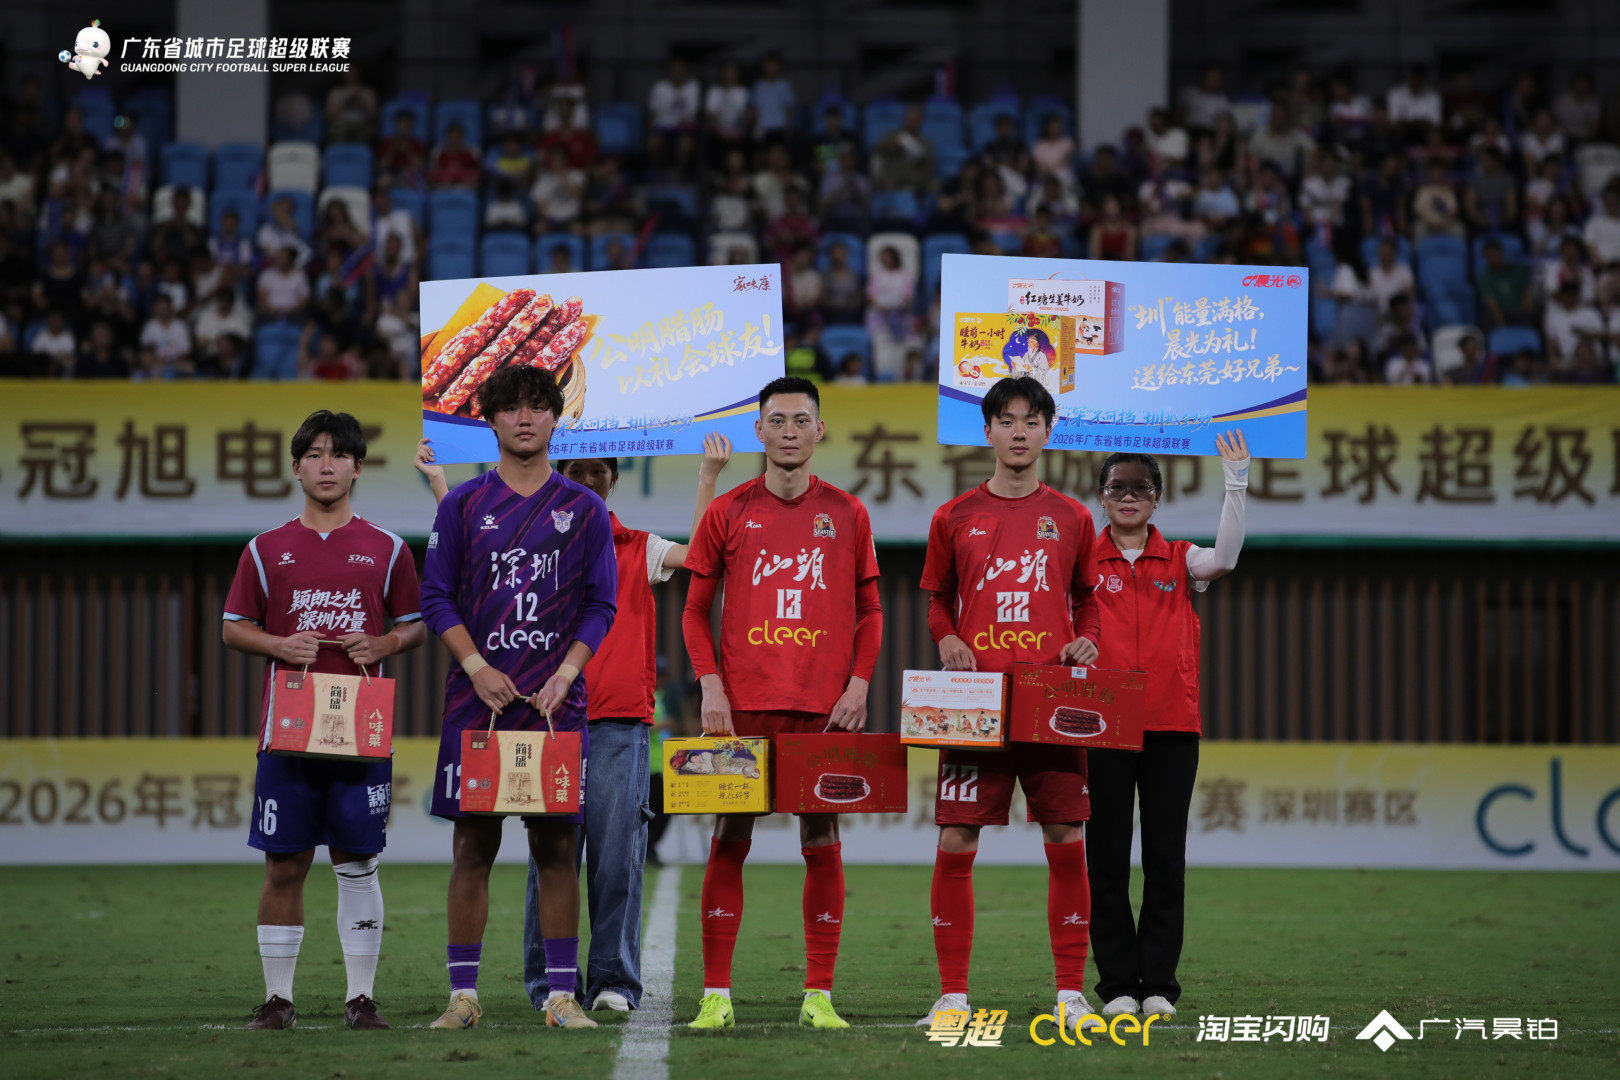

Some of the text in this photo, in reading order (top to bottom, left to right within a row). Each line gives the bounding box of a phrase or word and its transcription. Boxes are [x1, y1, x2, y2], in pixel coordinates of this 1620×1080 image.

[587, 302, 724, 370] 公明腊肠
[959, 326, 1006, 340] 睡前一小时
[961, 338, 981, 351] 牛奶
[1162, 328, 1257, 361] 晨光为礼！
[1053, 433, 1191, 450] 2026年广东省城市足球超级联赛
[491, 548, 560, 591] 深圳
[288, 588, 363, 615] 颖朗之光
[514, 592, 538, 622] 12
[776, 588, 803, 619] 13
[996, 592, 1030, 623] 22
[296, 610, 368, 633] 深圳力量
[747, 619, 822, 648] cleer
[486, 623, 554, 650] cleer
[973, 624, 1047, 651] cleer
[941, 764, 978, 802] 22
[258, 796, 278, 836] 6
